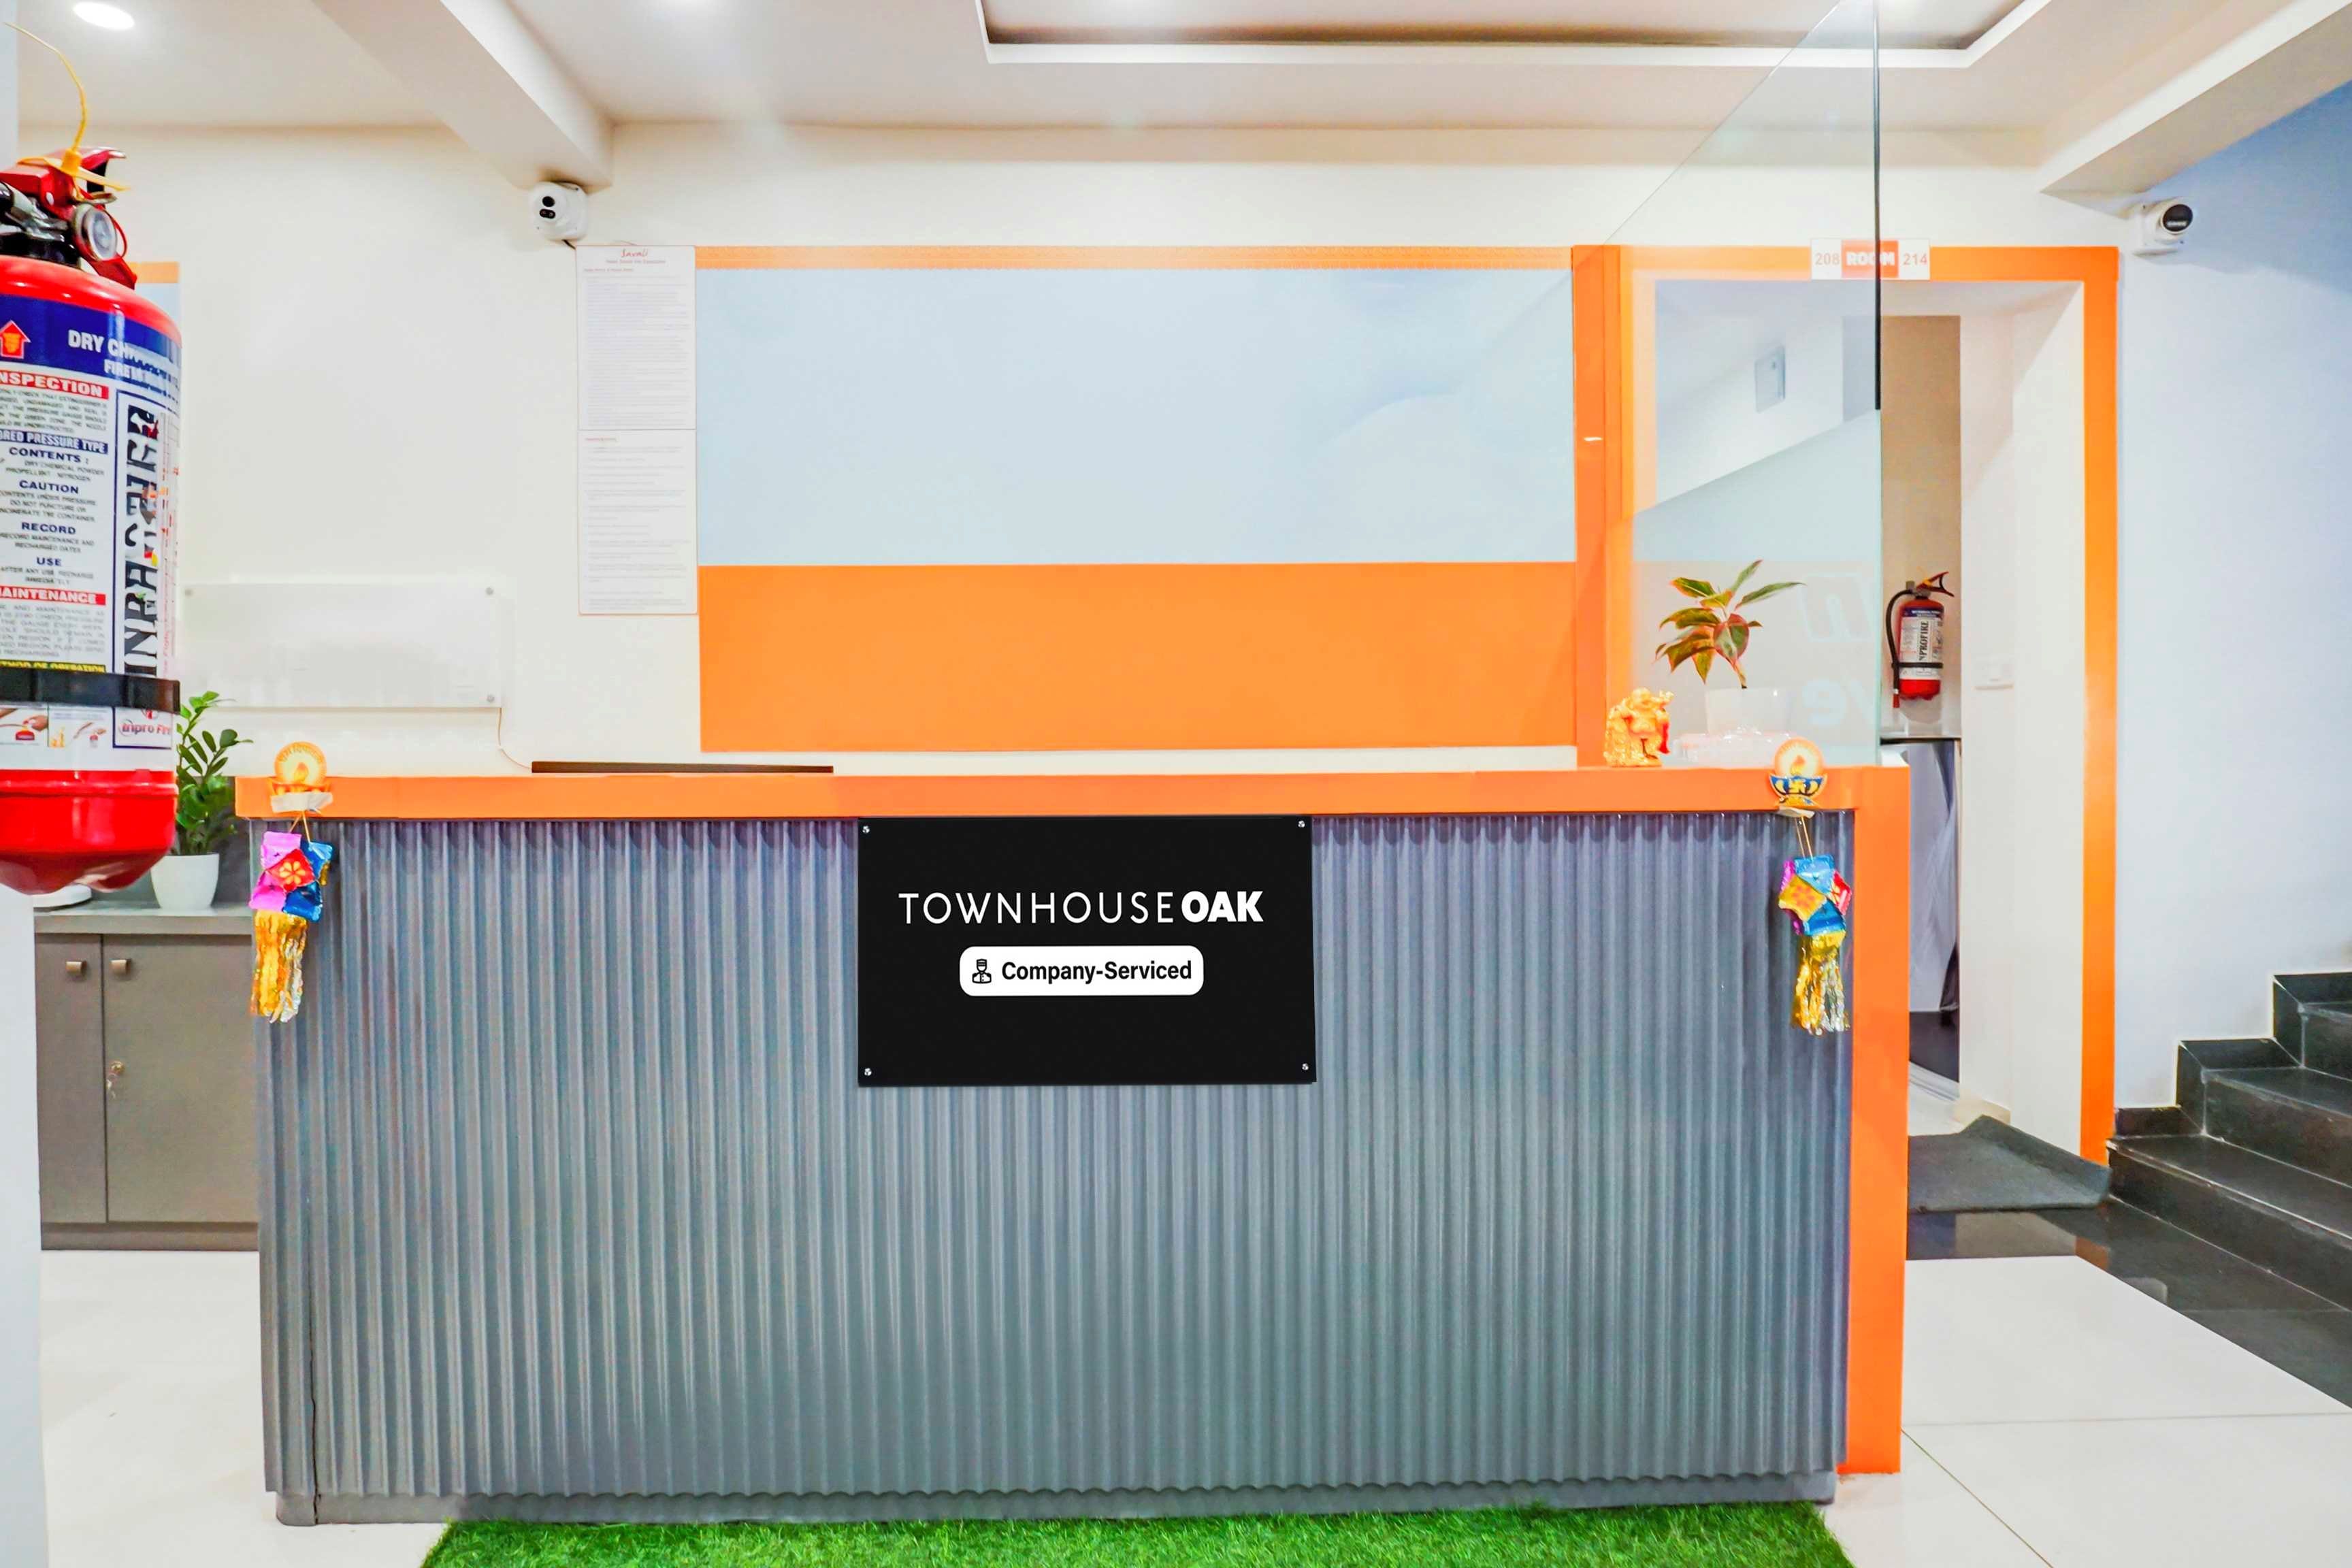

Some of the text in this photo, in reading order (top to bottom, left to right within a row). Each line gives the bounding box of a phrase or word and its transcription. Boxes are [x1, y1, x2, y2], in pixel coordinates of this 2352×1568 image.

[1815, 251, 1928, 266] 208 ROOM 214
[68, 329, 105, 353] DRY
[0, 372, 102, 397] NSPECTION
[0, 430, 24, 442] RED
[27, 431, 80, 450] PRESSURE
[9, 446, 81, 463] CONTENTS
[19, 480, 79, 494] CAUTION
[21, 521, 76, 535] RECORD
[36, 557, 62, 566] USE
[0, 587, 97, 604] AINTENANCE
[1918, 620, 1929, 661] NPROFIRE
[898, 890, 1264, 924] TOWNHOUSE OAK
[1001, 960, 1192, 984] Company-Serviced
